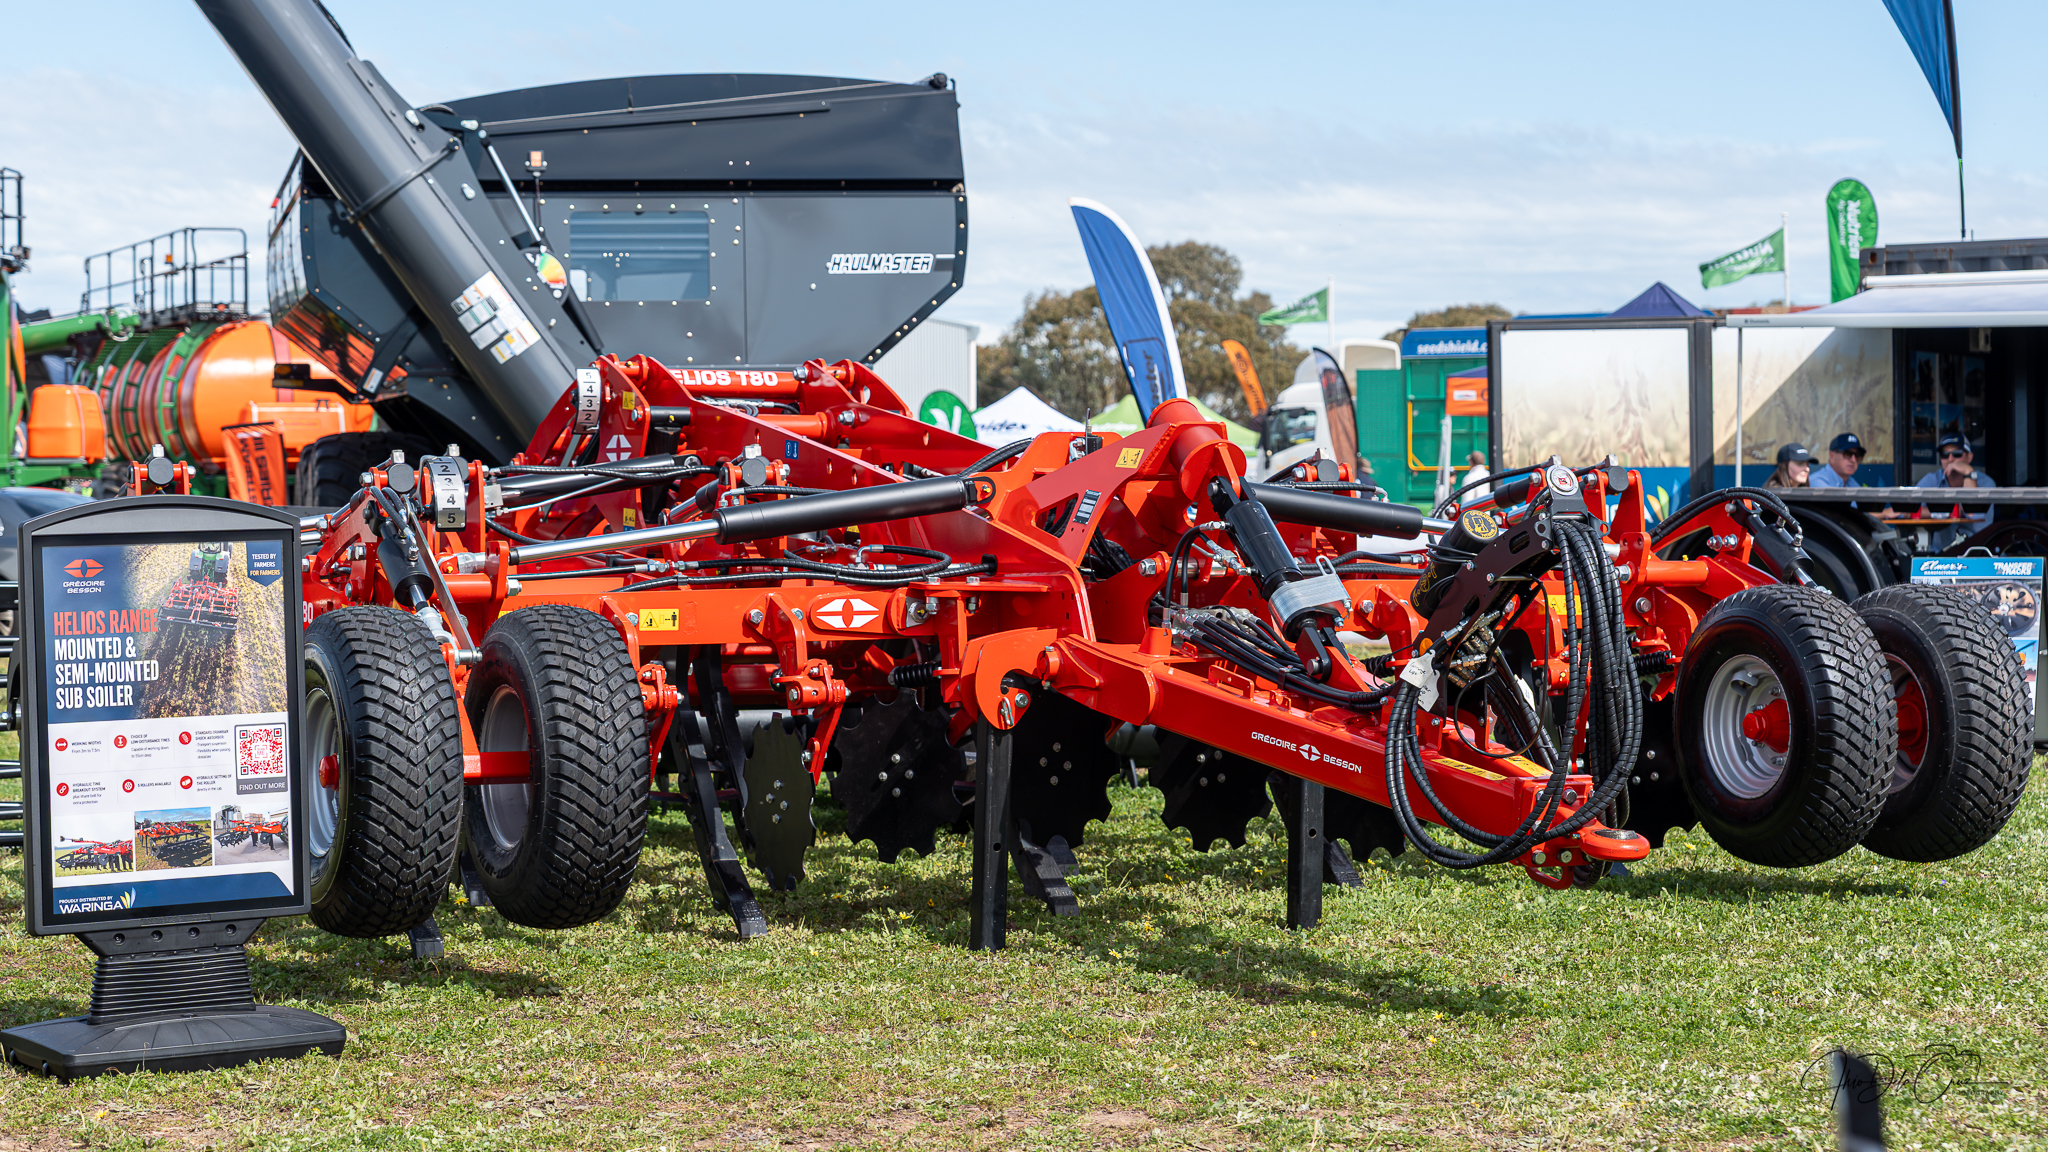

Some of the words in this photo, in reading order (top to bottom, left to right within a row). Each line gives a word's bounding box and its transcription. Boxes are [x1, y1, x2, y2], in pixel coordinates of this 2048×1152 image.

[828, 254, 934, 274] HAULMASTER
[585, 372, 592, 380] 5
[669, 370, 732, 386] ELIOS
[734, 370, 778, 387] T80
[586, 385, 593, 393] 4
[586, 400, 593, 408] 3
[584, 413, 592, 421] 2
[444, 478, 453, 486] 3
[447, 494, 456, 505] 4
[447, 513, 456, 523] 5
[54, 610, 106, 635] HELIOS
[110, 609, 158, 634] RANGE
[55, 637, 121, 660] MOUNTED
[126, 636, 136, 658] &
[56, 660, 159, 685] SEMI-MOUNTED
[56, 687, 83, 709] SUB
[86, 685, 133, 708] SOILER
[1323, 754, 1362, 774] BESSON
[59, 901, 123, 914] WARINGA
